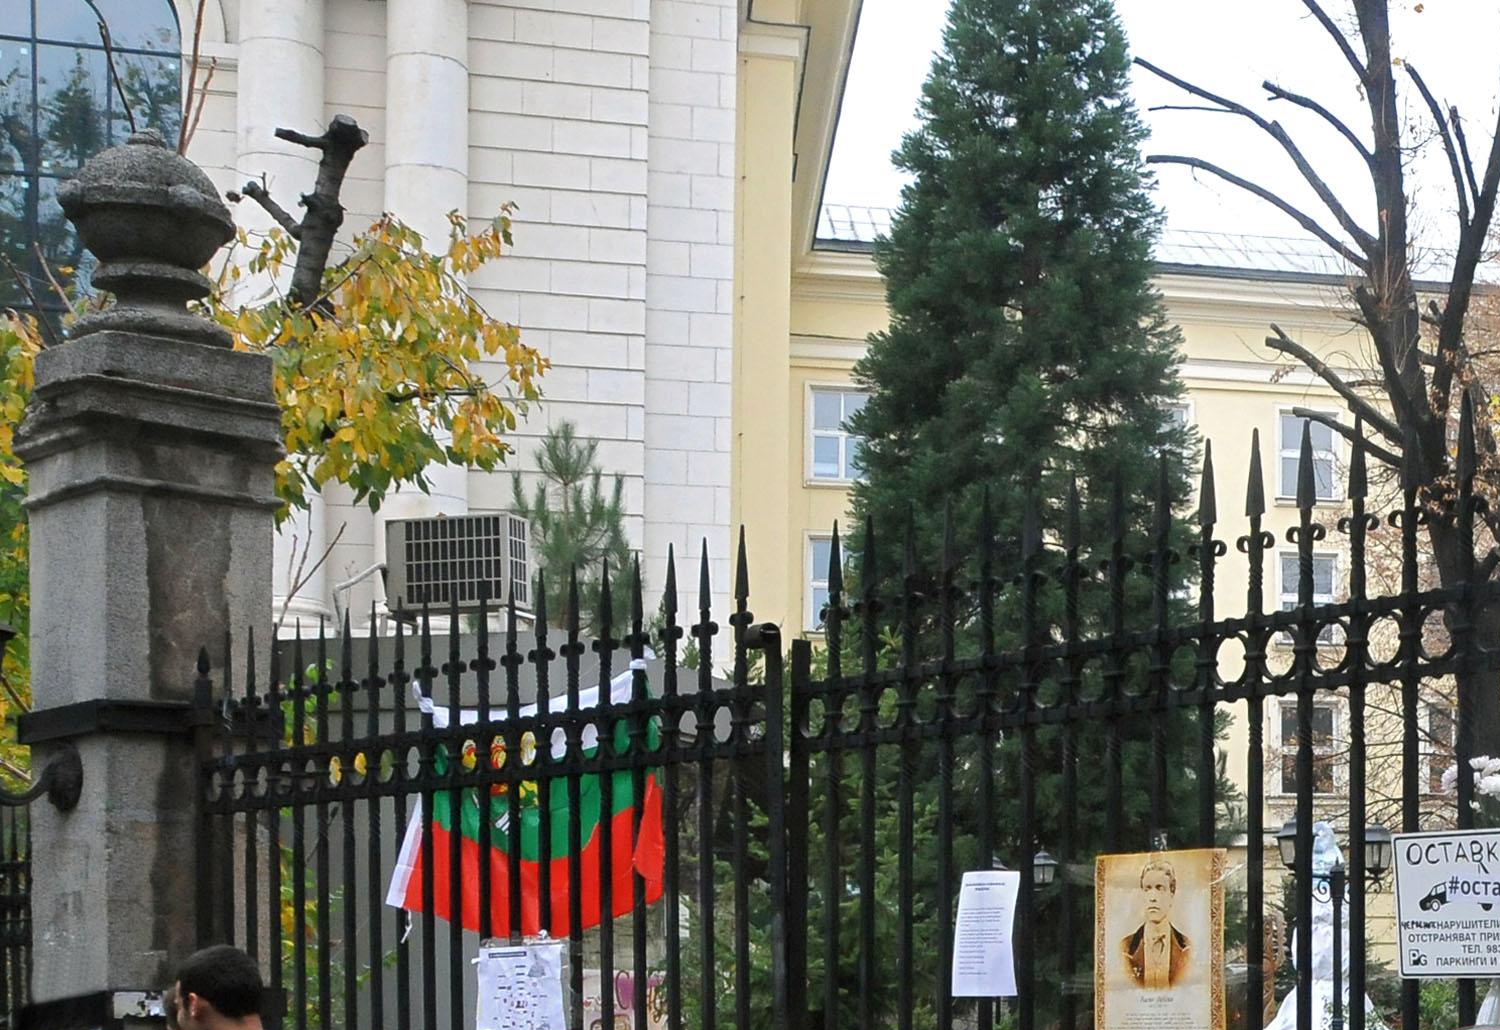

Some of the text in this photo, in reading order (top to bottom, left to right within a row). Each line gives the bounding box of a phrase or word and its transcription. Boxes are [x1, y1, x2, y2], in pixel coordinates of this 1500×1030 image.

[1408, 931, 1477, 943] ОТСТРАНЯВАТ
[1462, 944, 1483, 954] ТЕЛ.
[1436, 956, 1488, 967] ПАРКИНГИ
[1490, 955, 1498, 966] И
